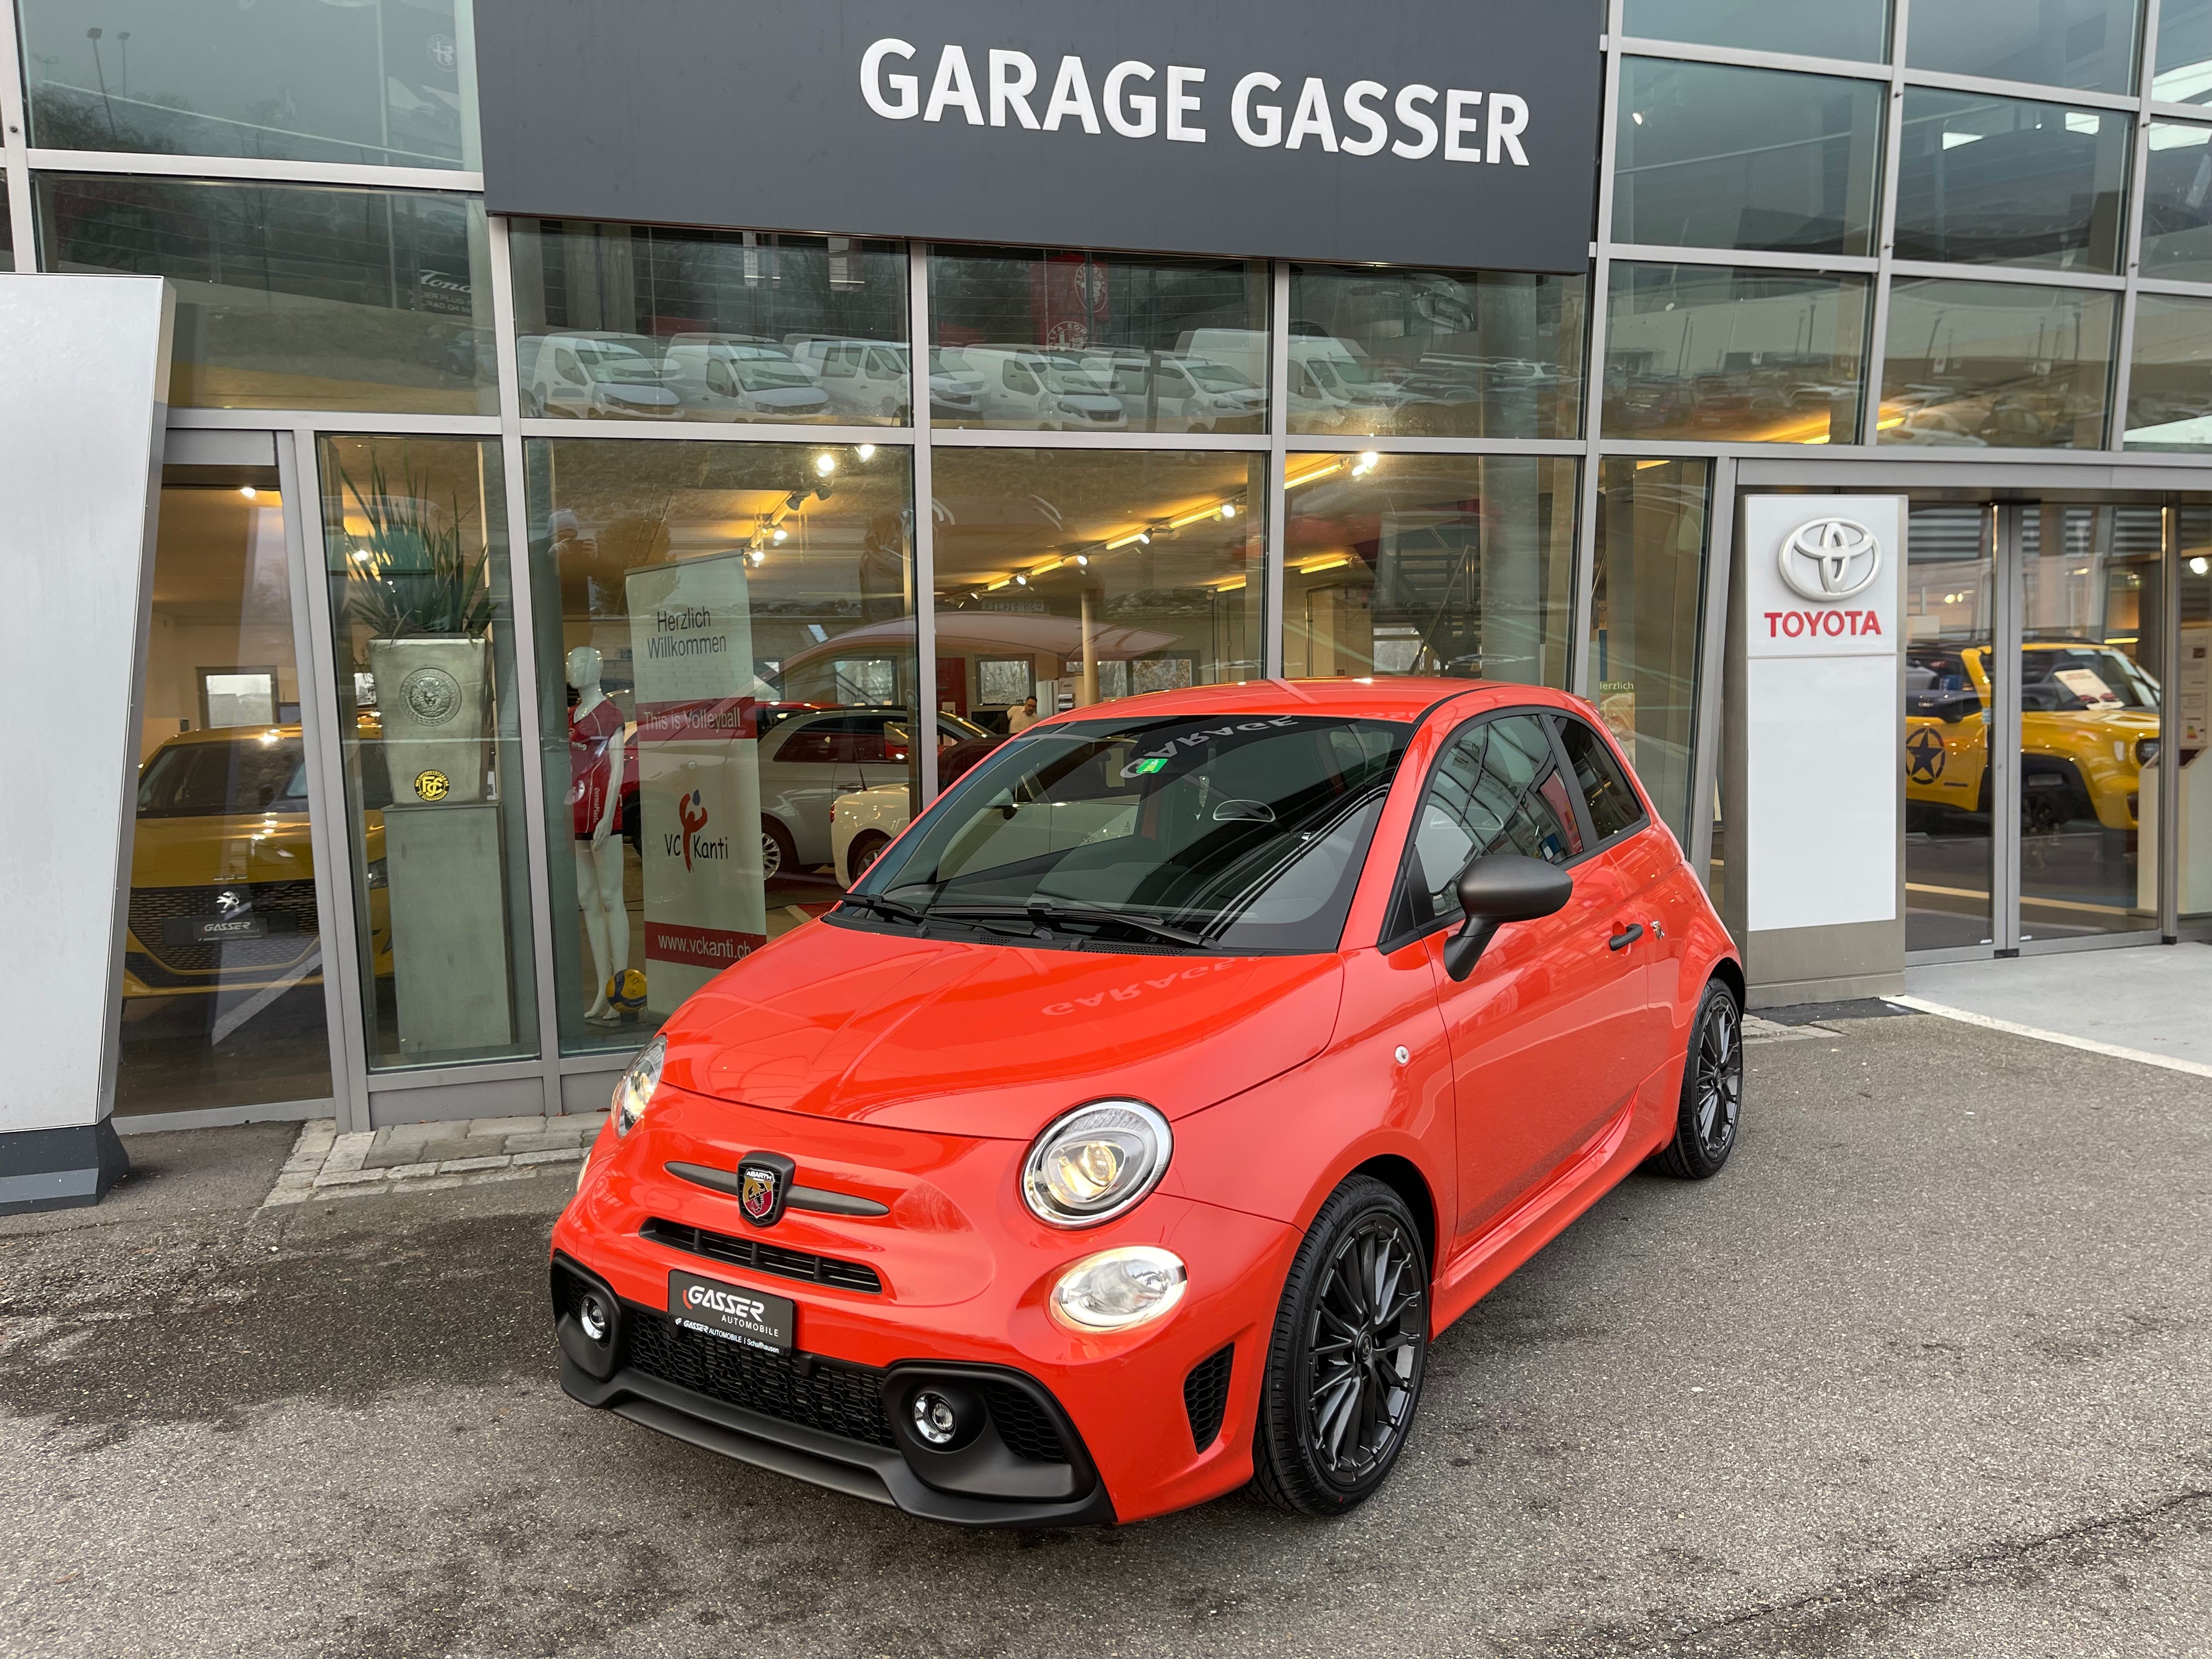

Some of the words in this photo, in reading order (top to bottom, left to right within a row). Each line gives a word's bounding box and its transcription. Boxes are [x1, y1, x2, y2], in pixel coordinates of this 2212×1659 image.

[860, 38, 1206, 143] GARAGE
[1231, 72, 1530, 166] GASSER
[657, 606, 711, 632] Herzlich
[1764, 611, 1882, 637] TOYOTA
[647, 635, 727, 658] Willkommen
[644, 711, 668, 731] This
[672, 710, 681, 730] is
[685, 707, 741, 733] Volleyball
[664, 833, 681, 856] VC
[693, 834, 729, 860] Kanti
[204, 922, 251, 932] GASSER
[746, 1171, 772, 1181] ABARTH
[688, 1285, 765, 1323] GASSER
[684, 1320, 709, 1333] GASSER
[709, 1328, 742, 1343] AUTOMOBILE
[747, 1338, 780, 1354] Schaffhausen
[721, 1314, 779, 1337] AUTOMOBILE
